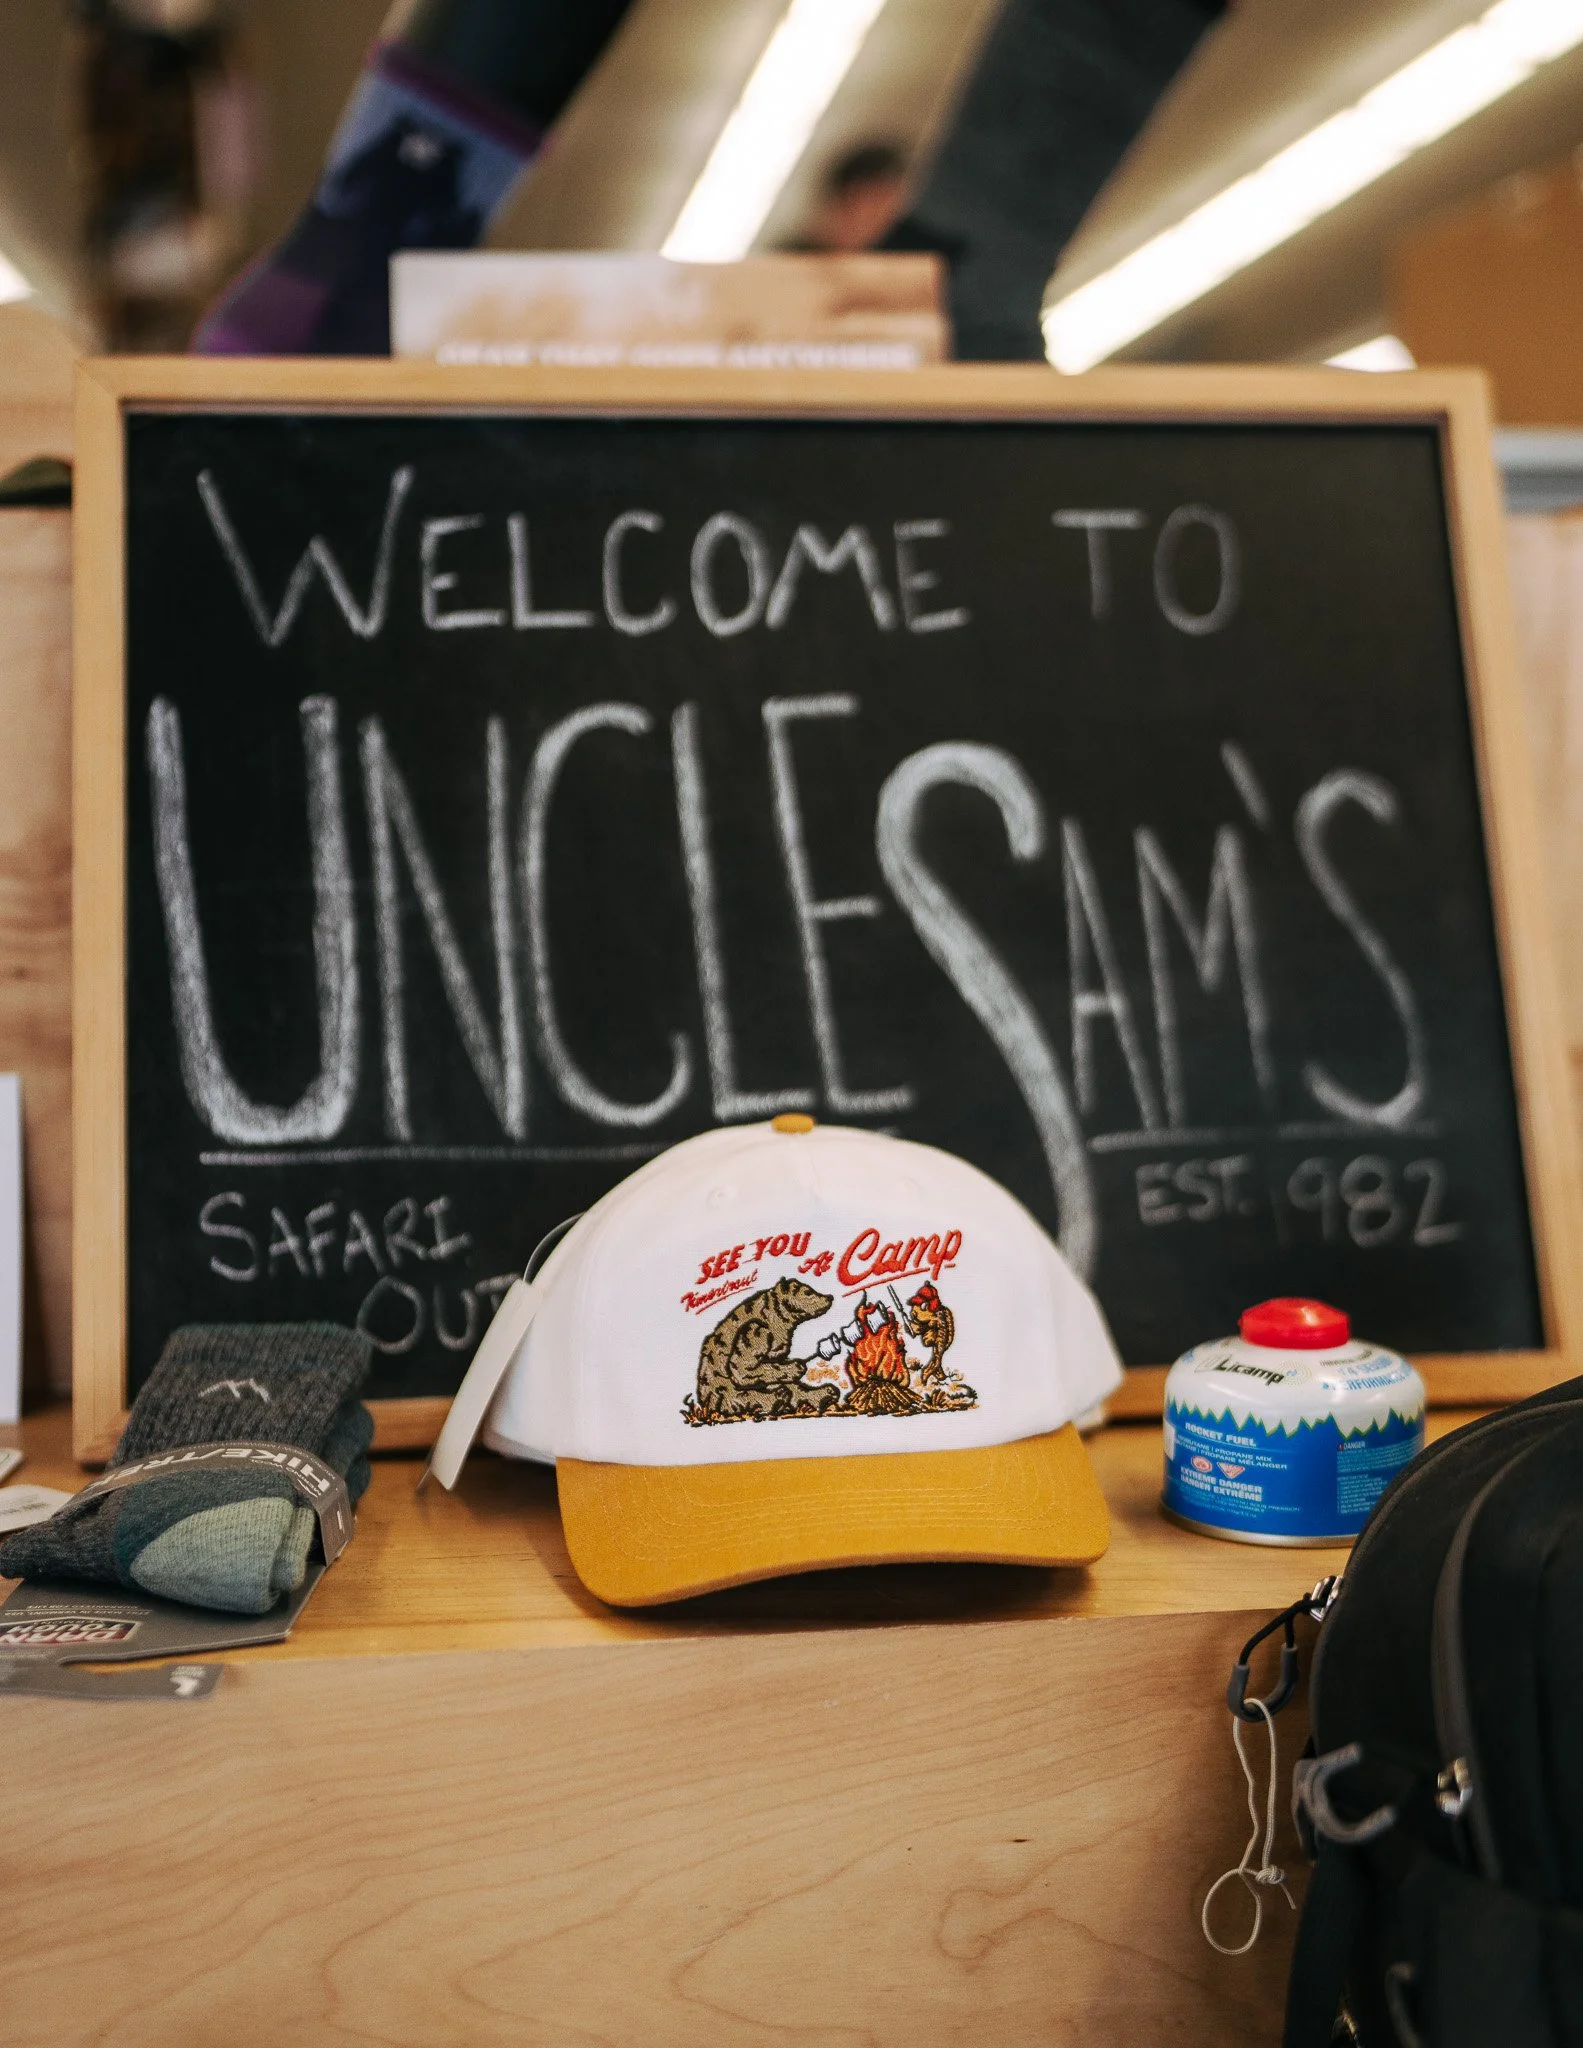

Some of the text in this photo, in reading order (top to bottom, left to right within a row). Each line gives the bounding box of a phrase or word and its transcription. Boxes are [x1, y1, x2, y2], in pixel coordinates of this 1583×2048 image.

[196, 465, 1242, 648] WELCOME TO
[146, 694, 917, 1143] UNCLE
[199, 1190, 472, 1282] SAFARI
[695, 1243, 745, 1284] SEE
[746, 1231, 812, 1263] YOU
[836, 1227, 963, 1289] Camp
[1185, 1422, 1257, 1447] ROCKET FUEL
[1343, 1440, 1366, 1450] DANGER
[1201, 1450, 1236, 1464] PROPANE
[1215, 1447, 1253, 1462] PROPANE
[1181, 1474, 1211, 1491] DANGER
[1219, 1478, 1263, 1493] DANGER
